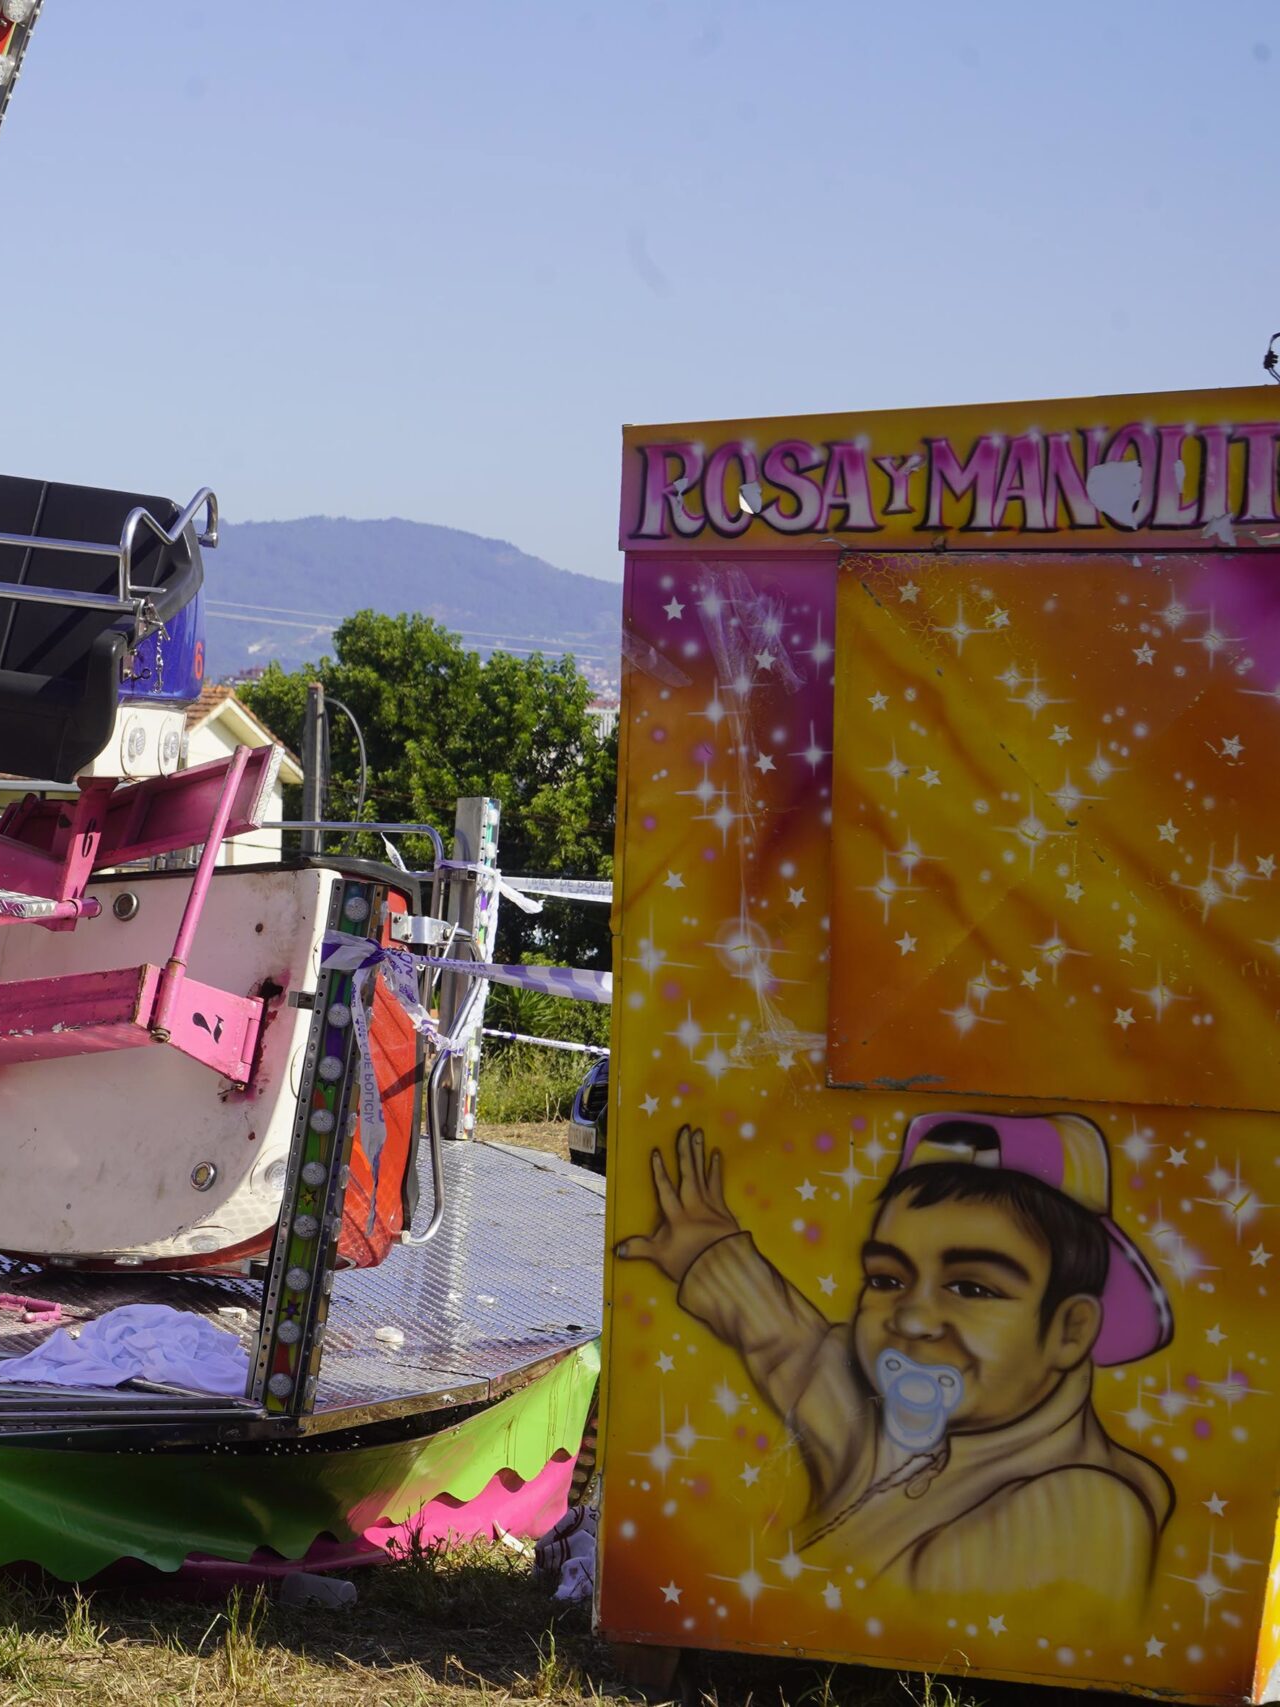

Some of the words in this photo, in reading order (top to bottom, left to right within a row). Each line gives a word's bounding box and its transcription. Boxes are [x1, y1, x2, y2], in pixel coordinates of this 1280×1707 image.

[627, 439, 884, 538] ROSA
[913, 420, 1280, 533] MANOLIT
[194, 640, 205, 681] 6
[81, 817, 97, 858] 6
